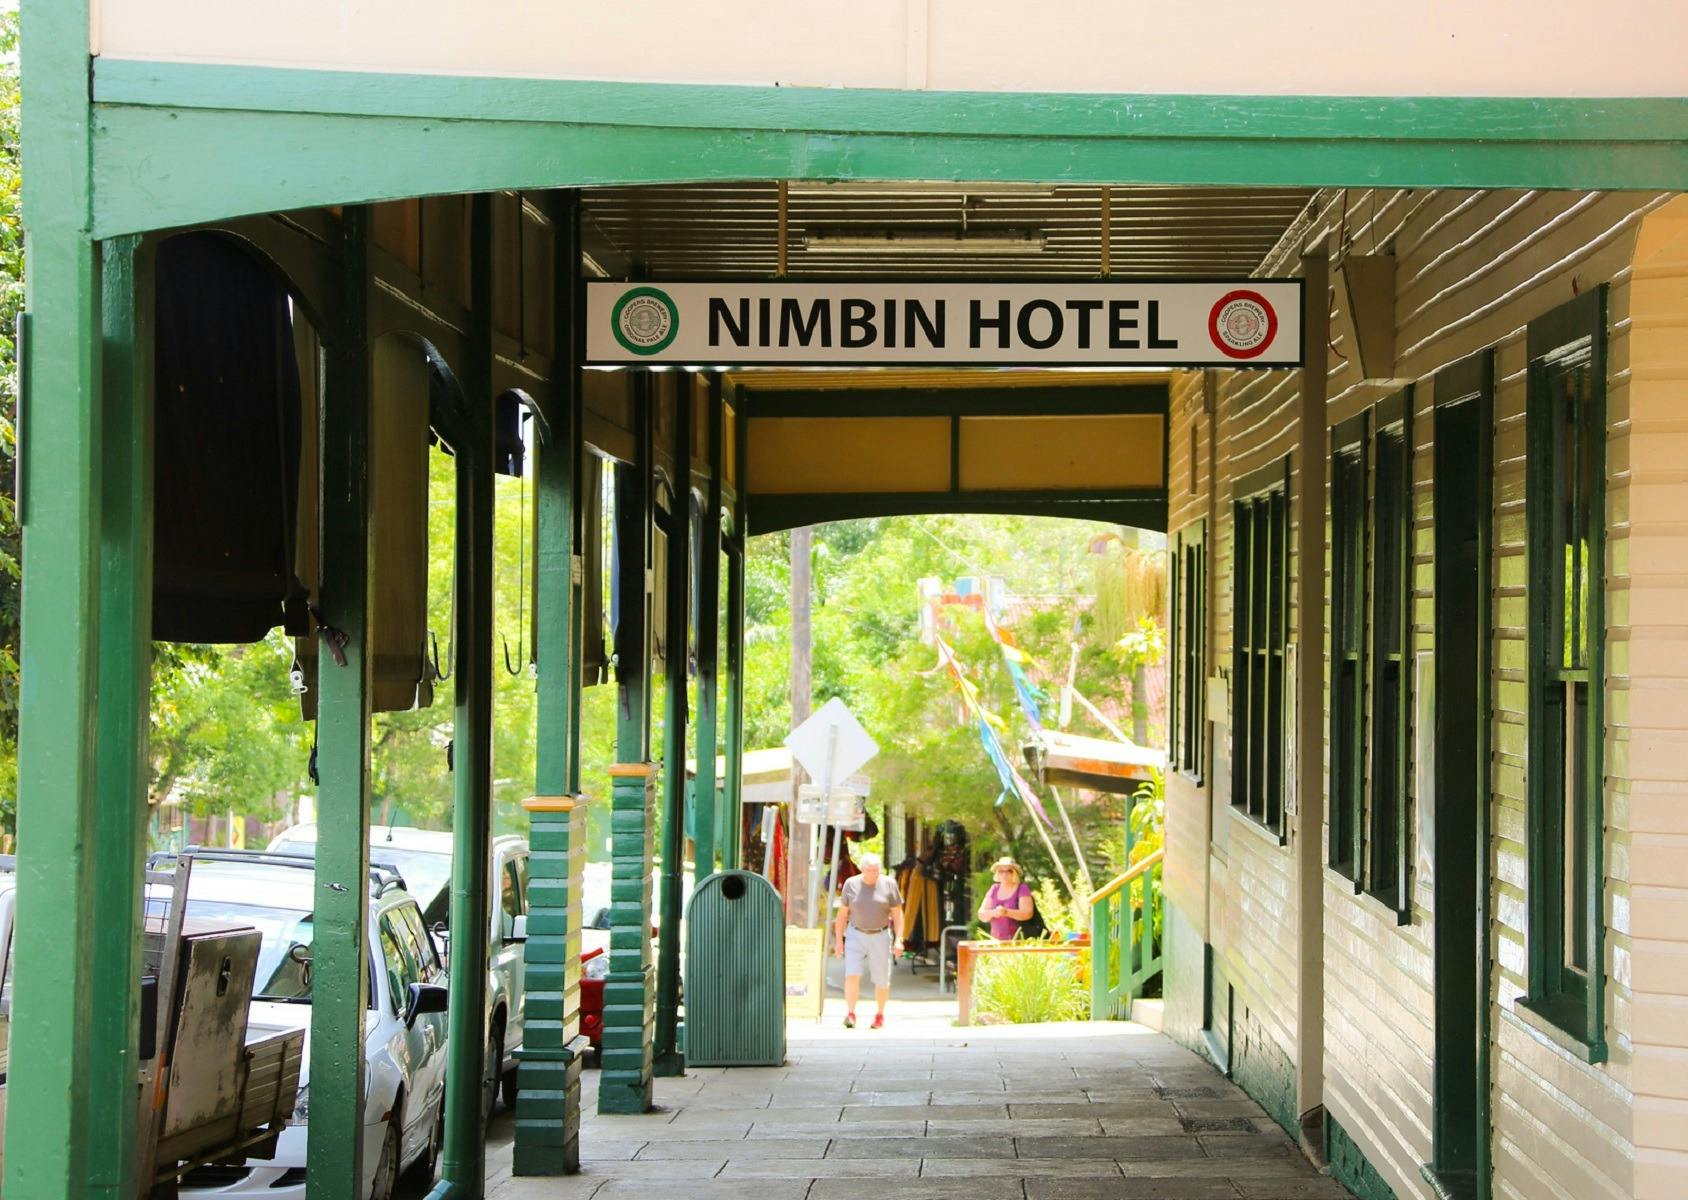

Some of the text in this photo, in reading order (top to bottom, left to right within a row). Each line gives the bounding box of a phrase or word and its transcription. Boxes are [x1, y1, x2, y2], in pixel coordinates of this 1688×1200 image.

[1221, 303, 1265, 323] COOPERS BREWERY
[708, 297, 1179, 350] NIMBIN HOTEL
[647, 335, 661, 343] PALE
[1223, 331, 1263, 347] SPARKLING ALE
